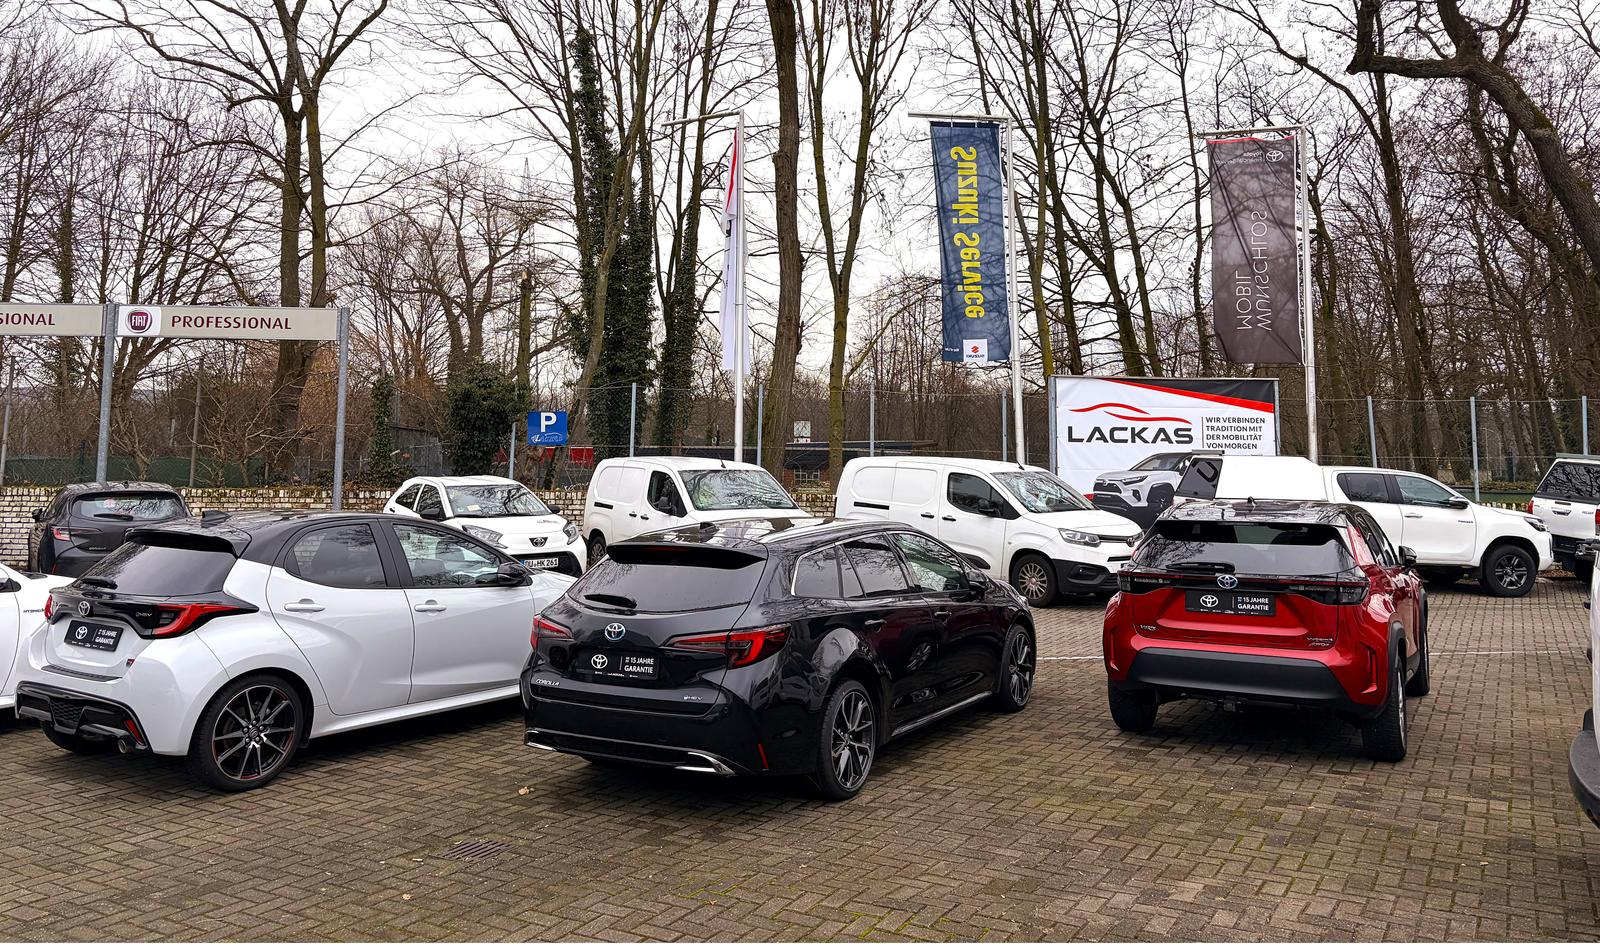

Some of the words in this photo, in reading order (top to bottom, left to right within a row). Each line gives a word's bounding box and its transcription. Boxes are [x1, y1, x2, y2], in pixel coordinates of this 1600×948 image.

[131, 314, 148, 326] FIAT
[171, 315, 292, 330] PROFESSIONAL
[540, 412, 557, 433] P
[1205, 416, 1221, 424] WIR
[1221, 416, 1266, 424] VERBINDEN
[1067, 426, 1194, 444] LACKAS
[1221, 432, 1262, 441] MOBILITÄT
[1224, 442, 1258, 450] MORGEN
[546, 558, 558, 566] 261
[1237, 603, 1269, 611] GARANTIE
[105, 630, 118, 638] JAHRE
[94, 636, 115, 645] GARANTIE
[630, 656, 637, 664] 15
[636, 657, 655, 665] JAHRE
[623, 664, 654, 674] GARANTIE
